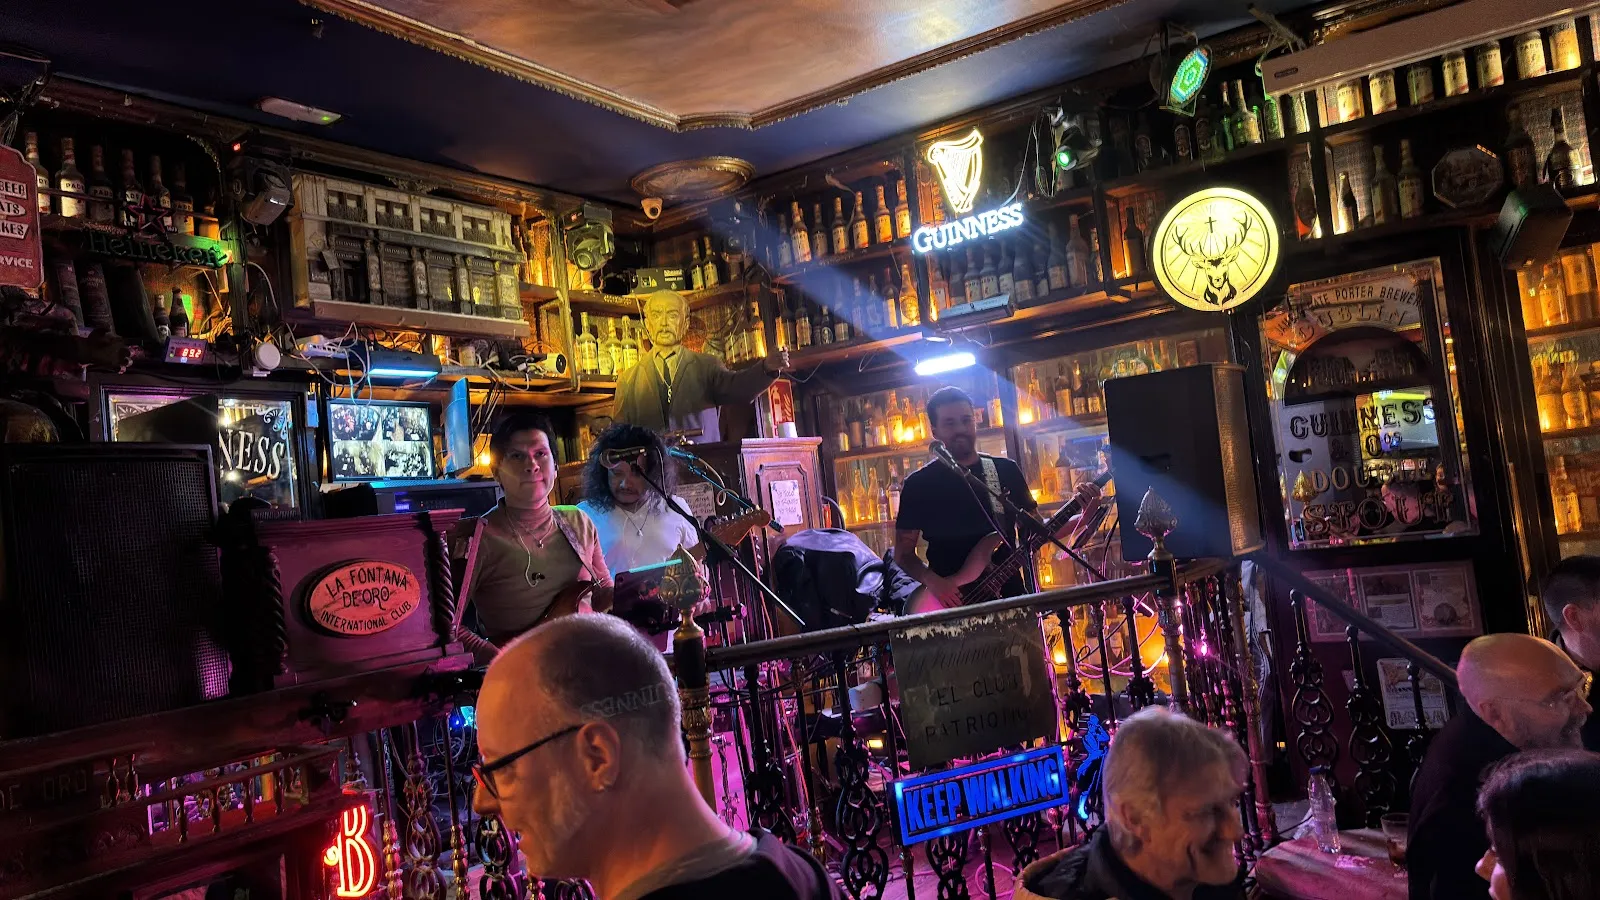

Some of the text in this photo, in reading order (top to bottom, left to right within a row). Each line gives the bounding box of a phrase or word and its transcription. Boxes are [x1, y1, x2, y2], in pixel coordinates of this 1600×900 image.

[0, 202, 20, 215] ATS
[912, 203, 1024, 254] GUINNESS
[90, 231, 226, 269] Heineken
[1311, 293, 1331, 309] ATE
[1335, 285, 1374, 301] PORTER
[325, 567, 408, 598] LA FONTANA
[321, 601, 412, 632] INTERNATIONAL CLUB
[905, 758, 1060, 832] KEEP WALKING
